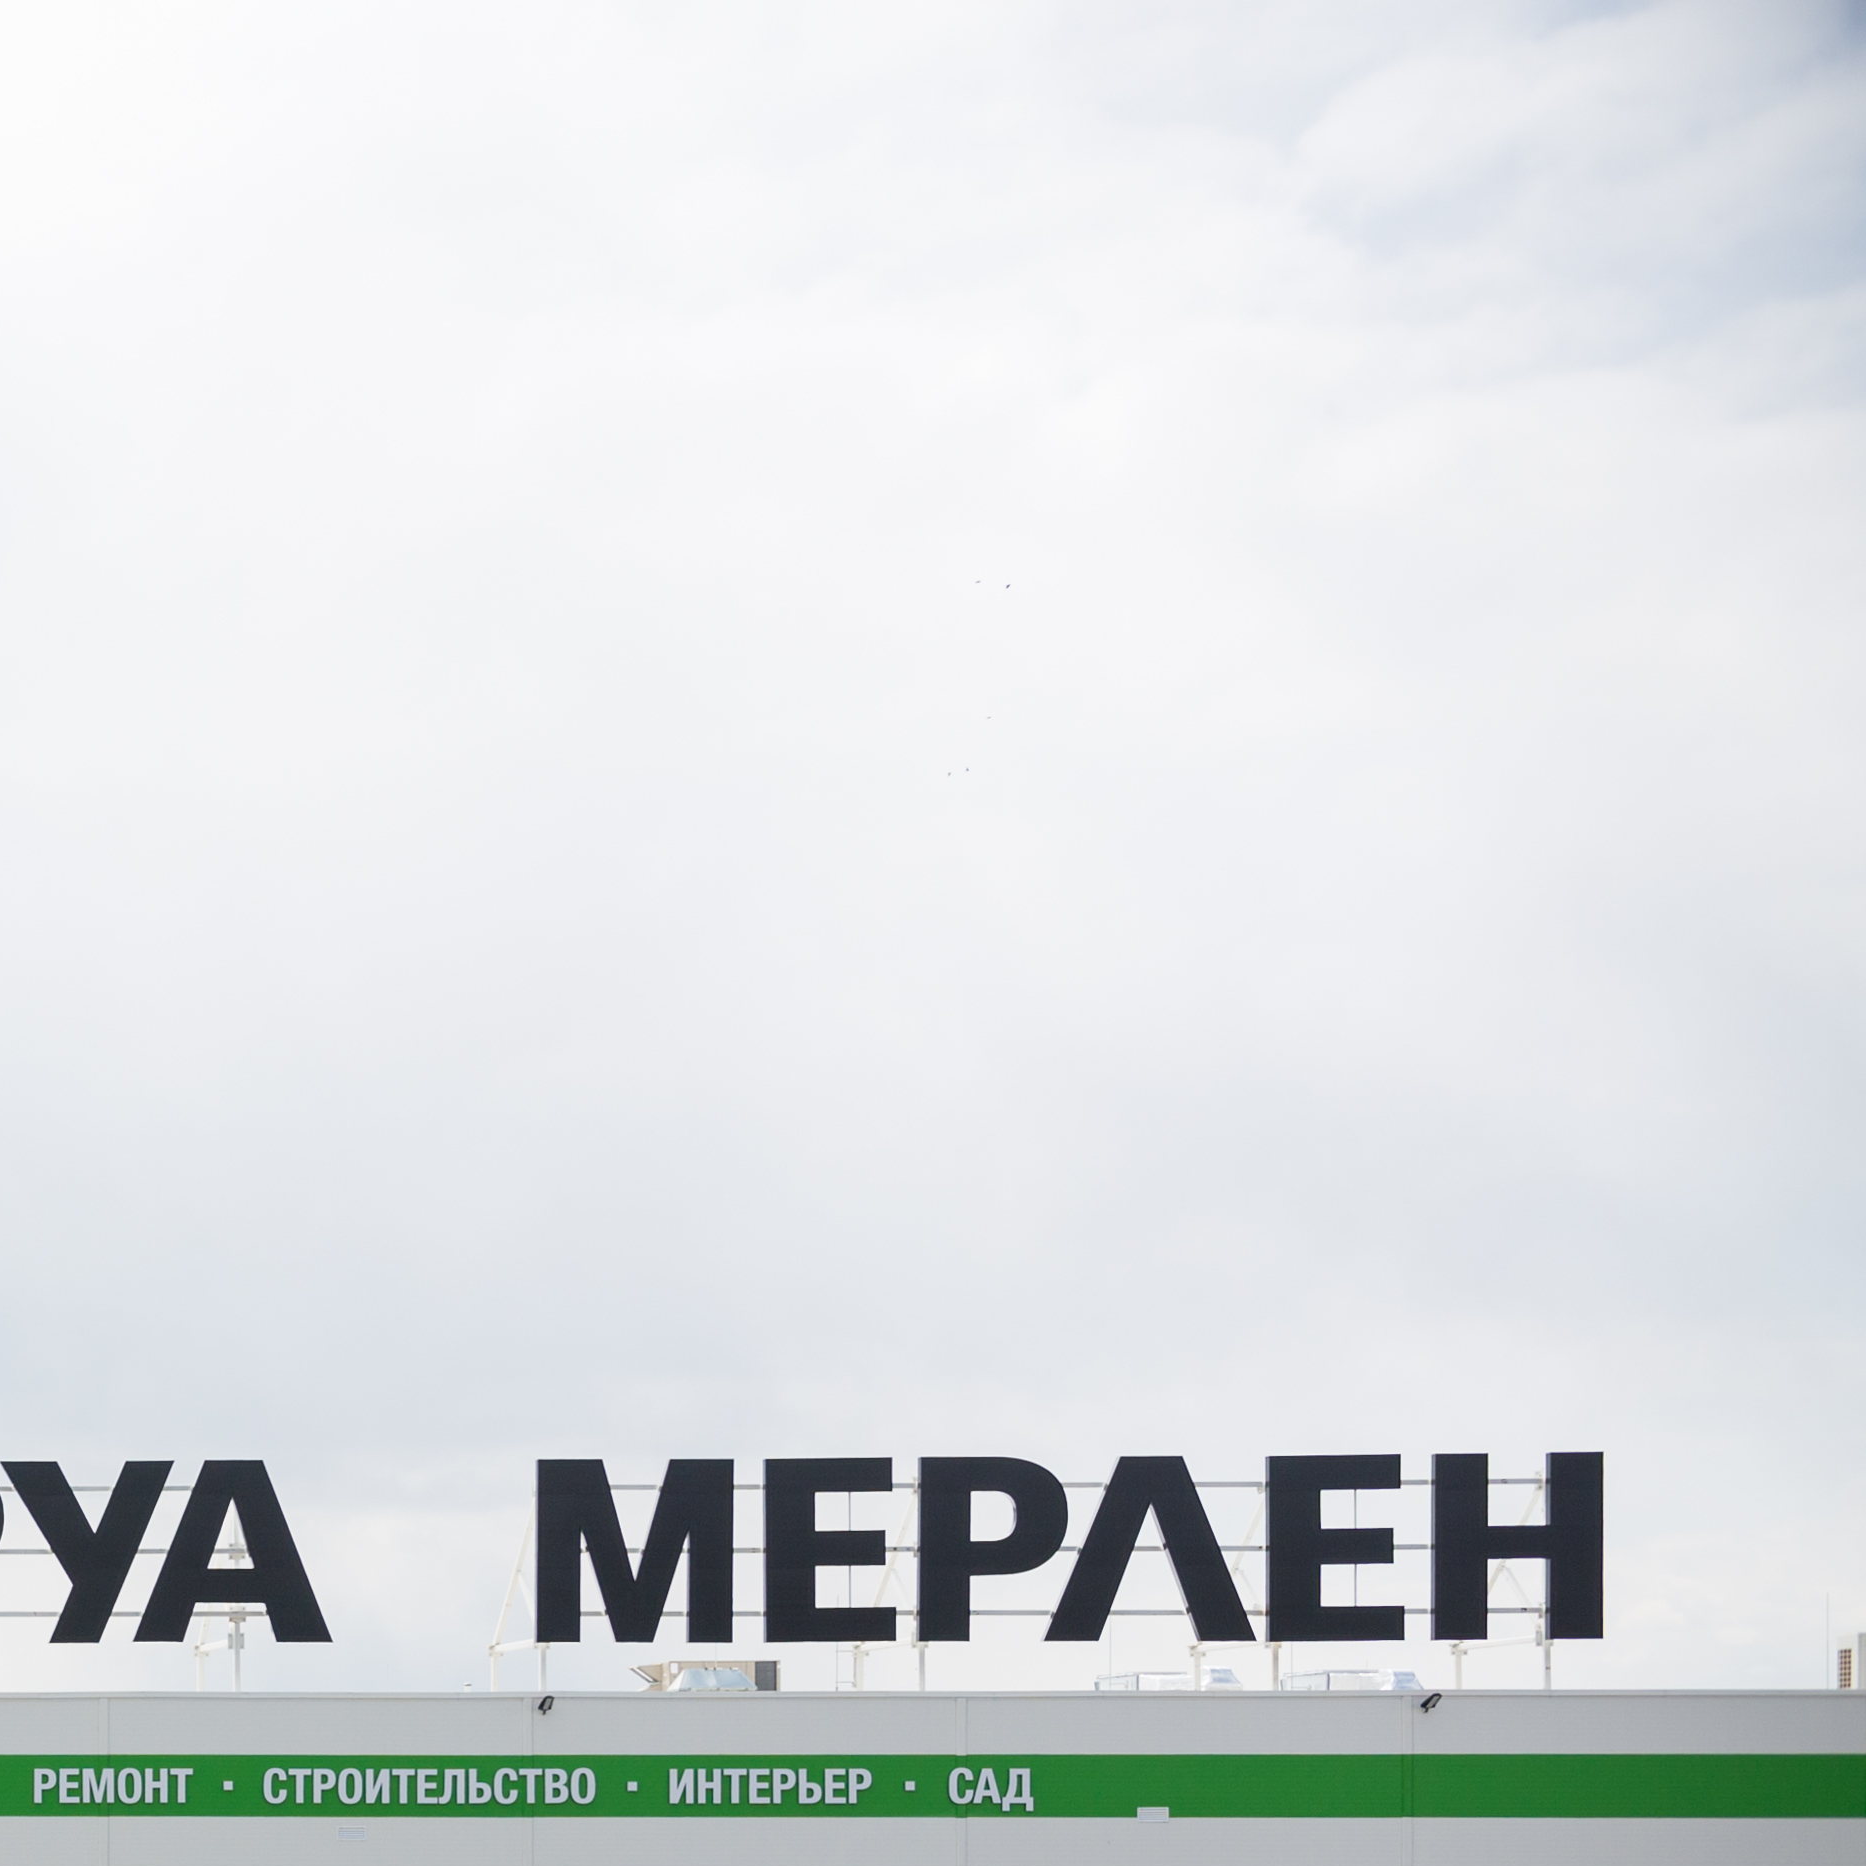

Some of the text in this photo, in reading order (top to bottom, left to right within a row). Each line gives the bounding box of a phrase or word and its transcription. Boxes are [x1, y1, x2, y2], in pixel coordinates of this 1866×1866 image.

[535, 1451, 1604, 1643] МЕРЛЕН
[33, 1767, 1035, 1812] РЕМОНТ СТРОИТЕЛЬСТВО ИНТЕРЬЕР САД
